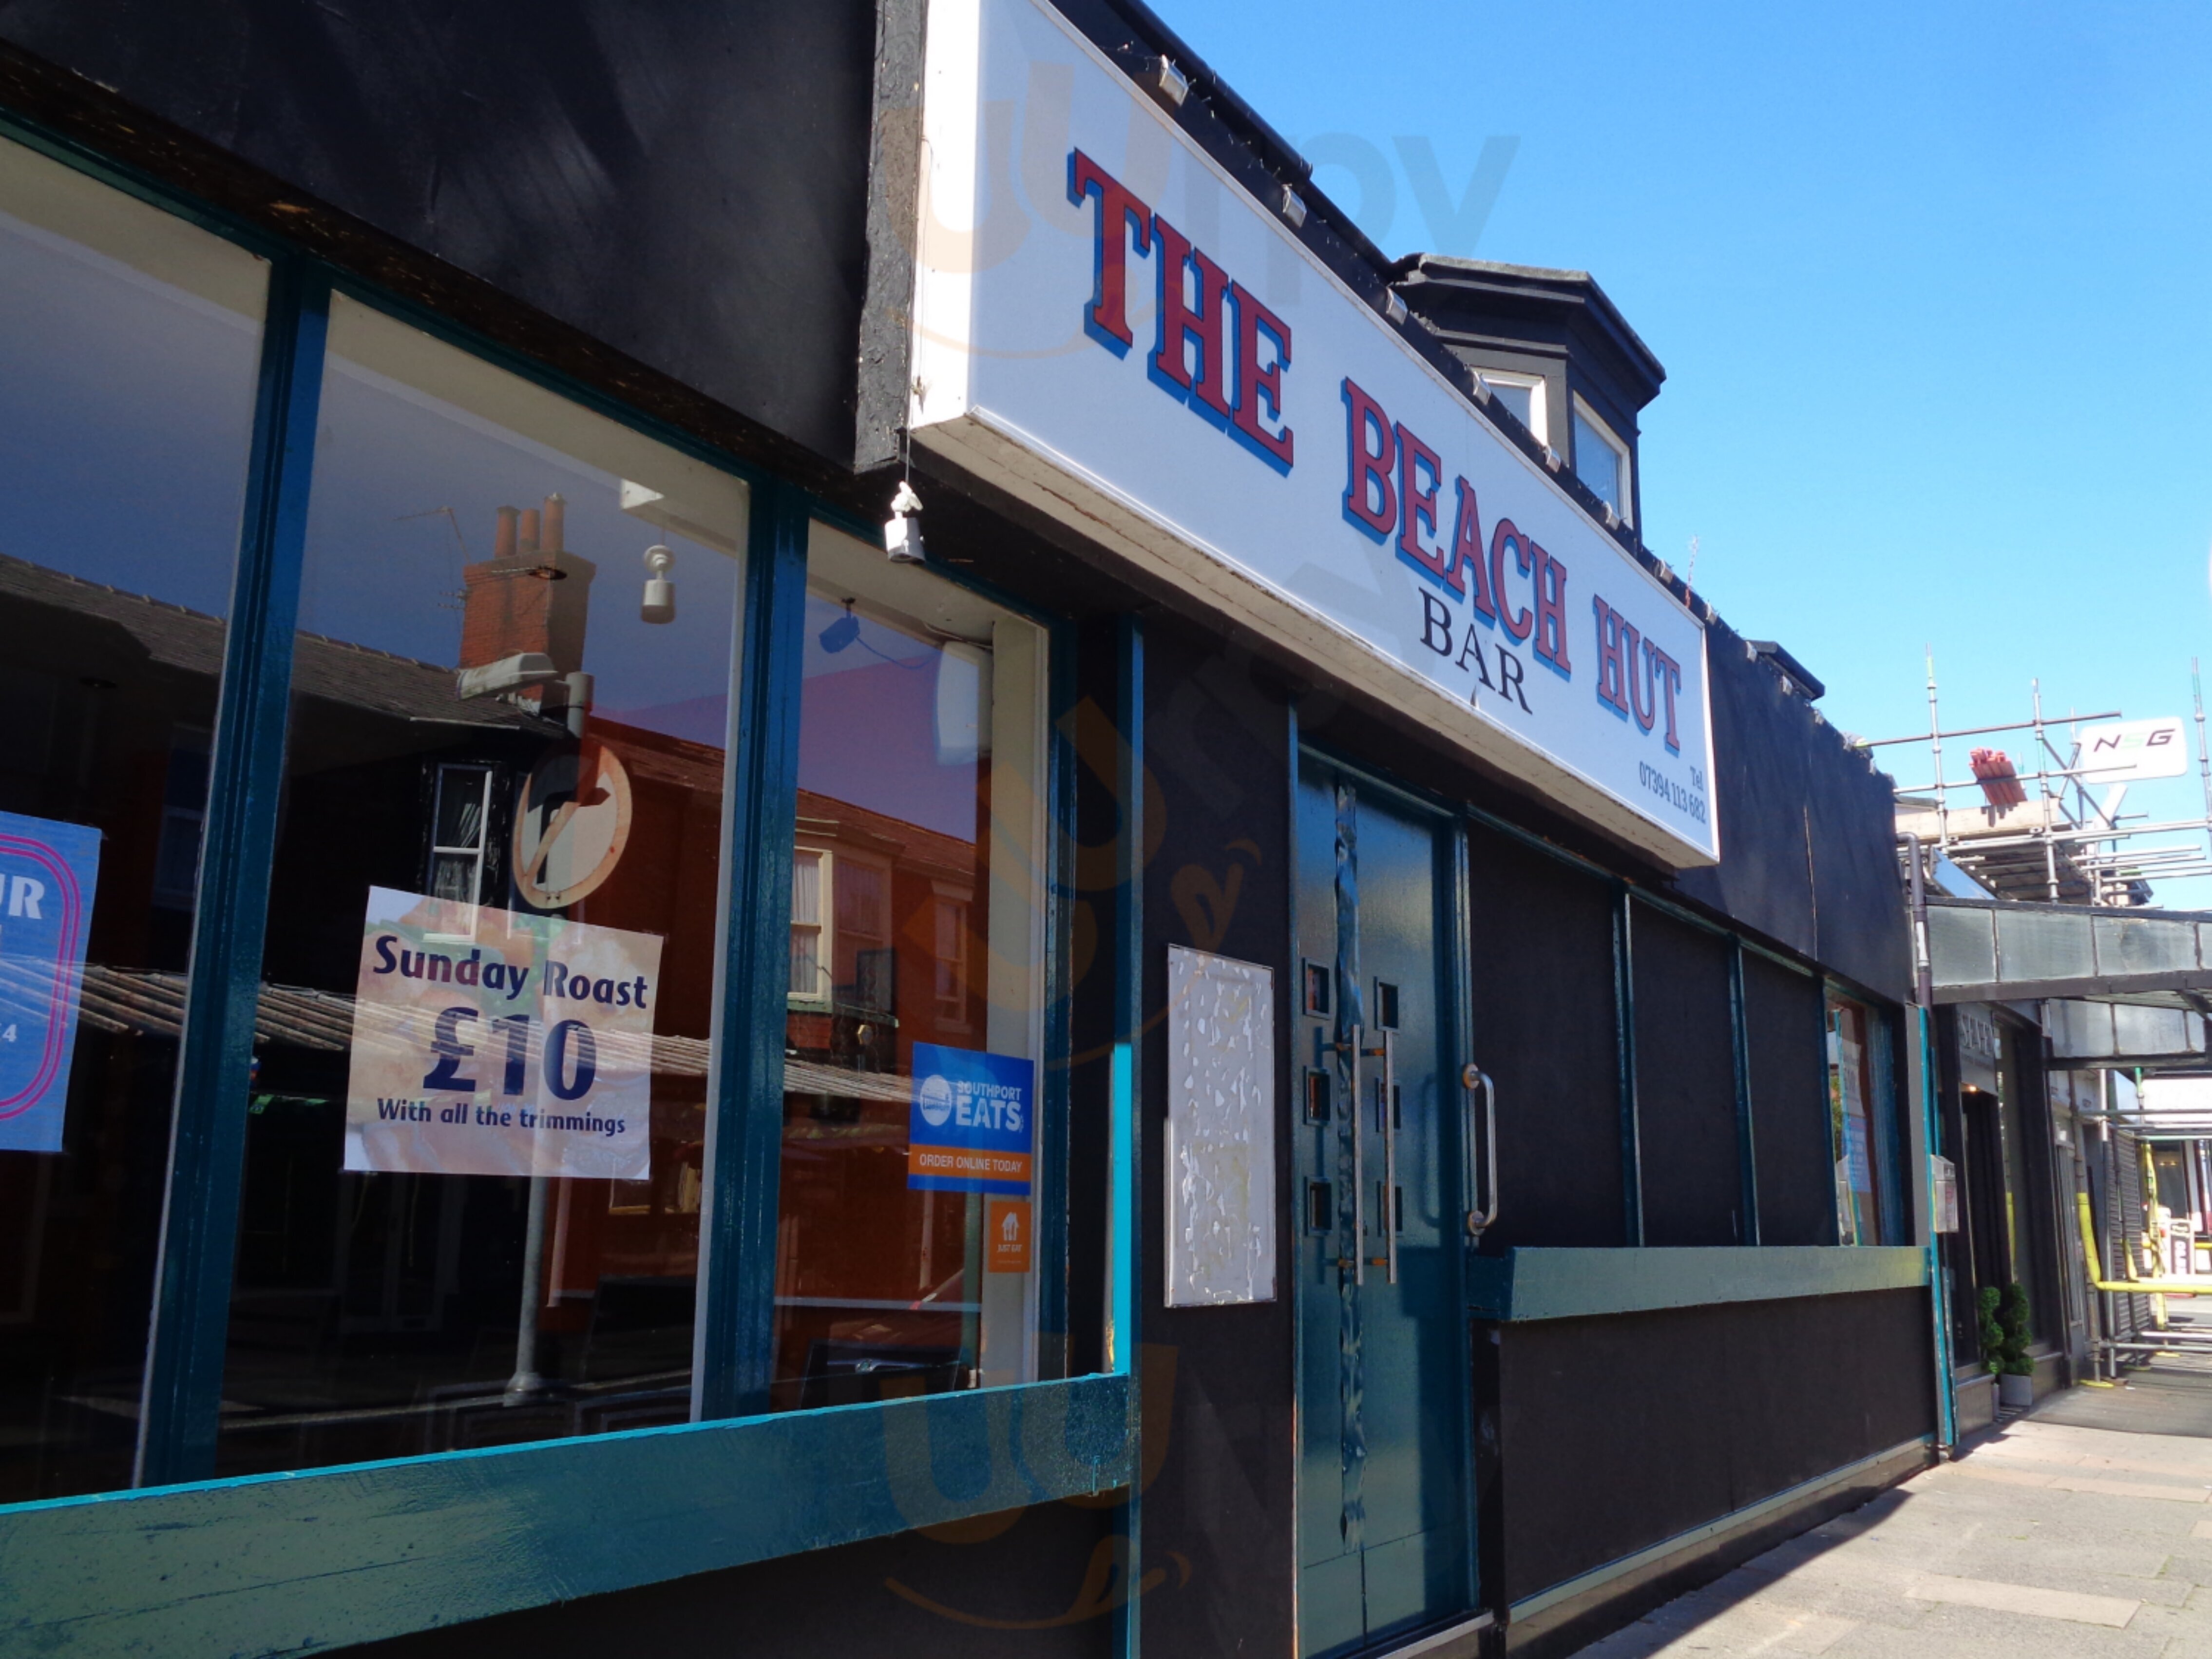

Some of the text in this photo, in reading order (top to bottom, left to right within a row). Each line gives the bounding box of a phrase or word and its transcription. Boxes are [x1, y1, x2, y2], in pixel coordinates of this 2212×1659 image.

[1067, 147, 1681, 757] THE BEACH HUT
[1419, 587, 1533, 714] BAR
[1640, 761, 1706, 824] 07394 113 682
[0, 873, 45, 920] R
[373, 935, 648, 1009] Sunday Roast
[422, 1006, 596, 1100] £10
[378, 1098, 626, 1137] With all the trimmings
[956, 1095, 1021, 1132] EATS
[957, 1080, 1022, 1100] SOUTHPORT
[920, 1153, 1023, 1173] ORDER ONLINE TODAY
